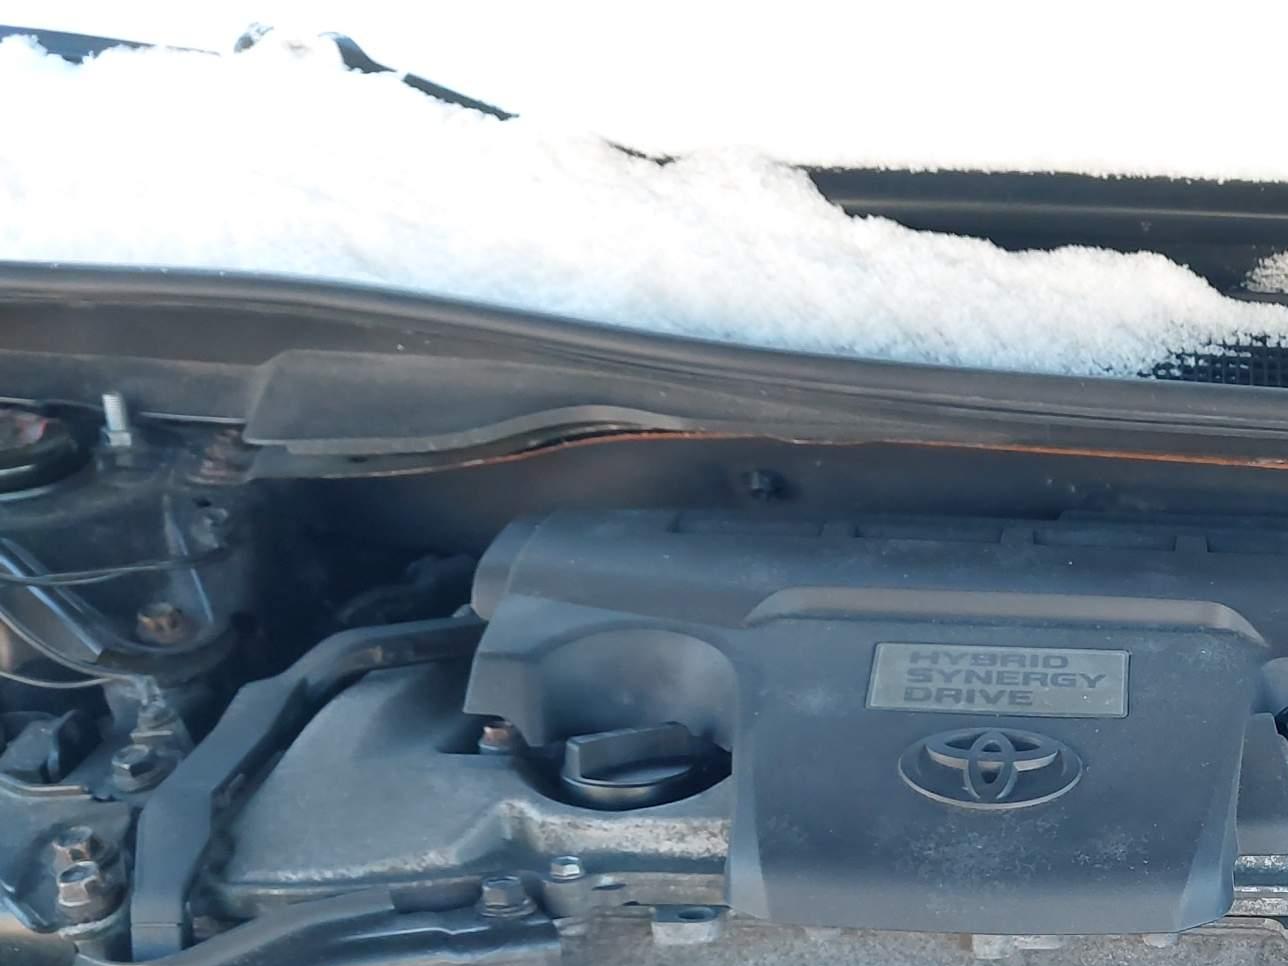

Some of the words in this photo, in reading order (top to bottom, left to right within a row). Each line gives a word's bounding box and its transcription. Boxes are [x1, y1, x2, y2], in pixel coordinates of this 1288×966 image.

[909, 651, 1069, 669] HYBRID
[906, 668, 1106, 689] SYNERGY
[903, 687, 1034, 706] DRIVE
